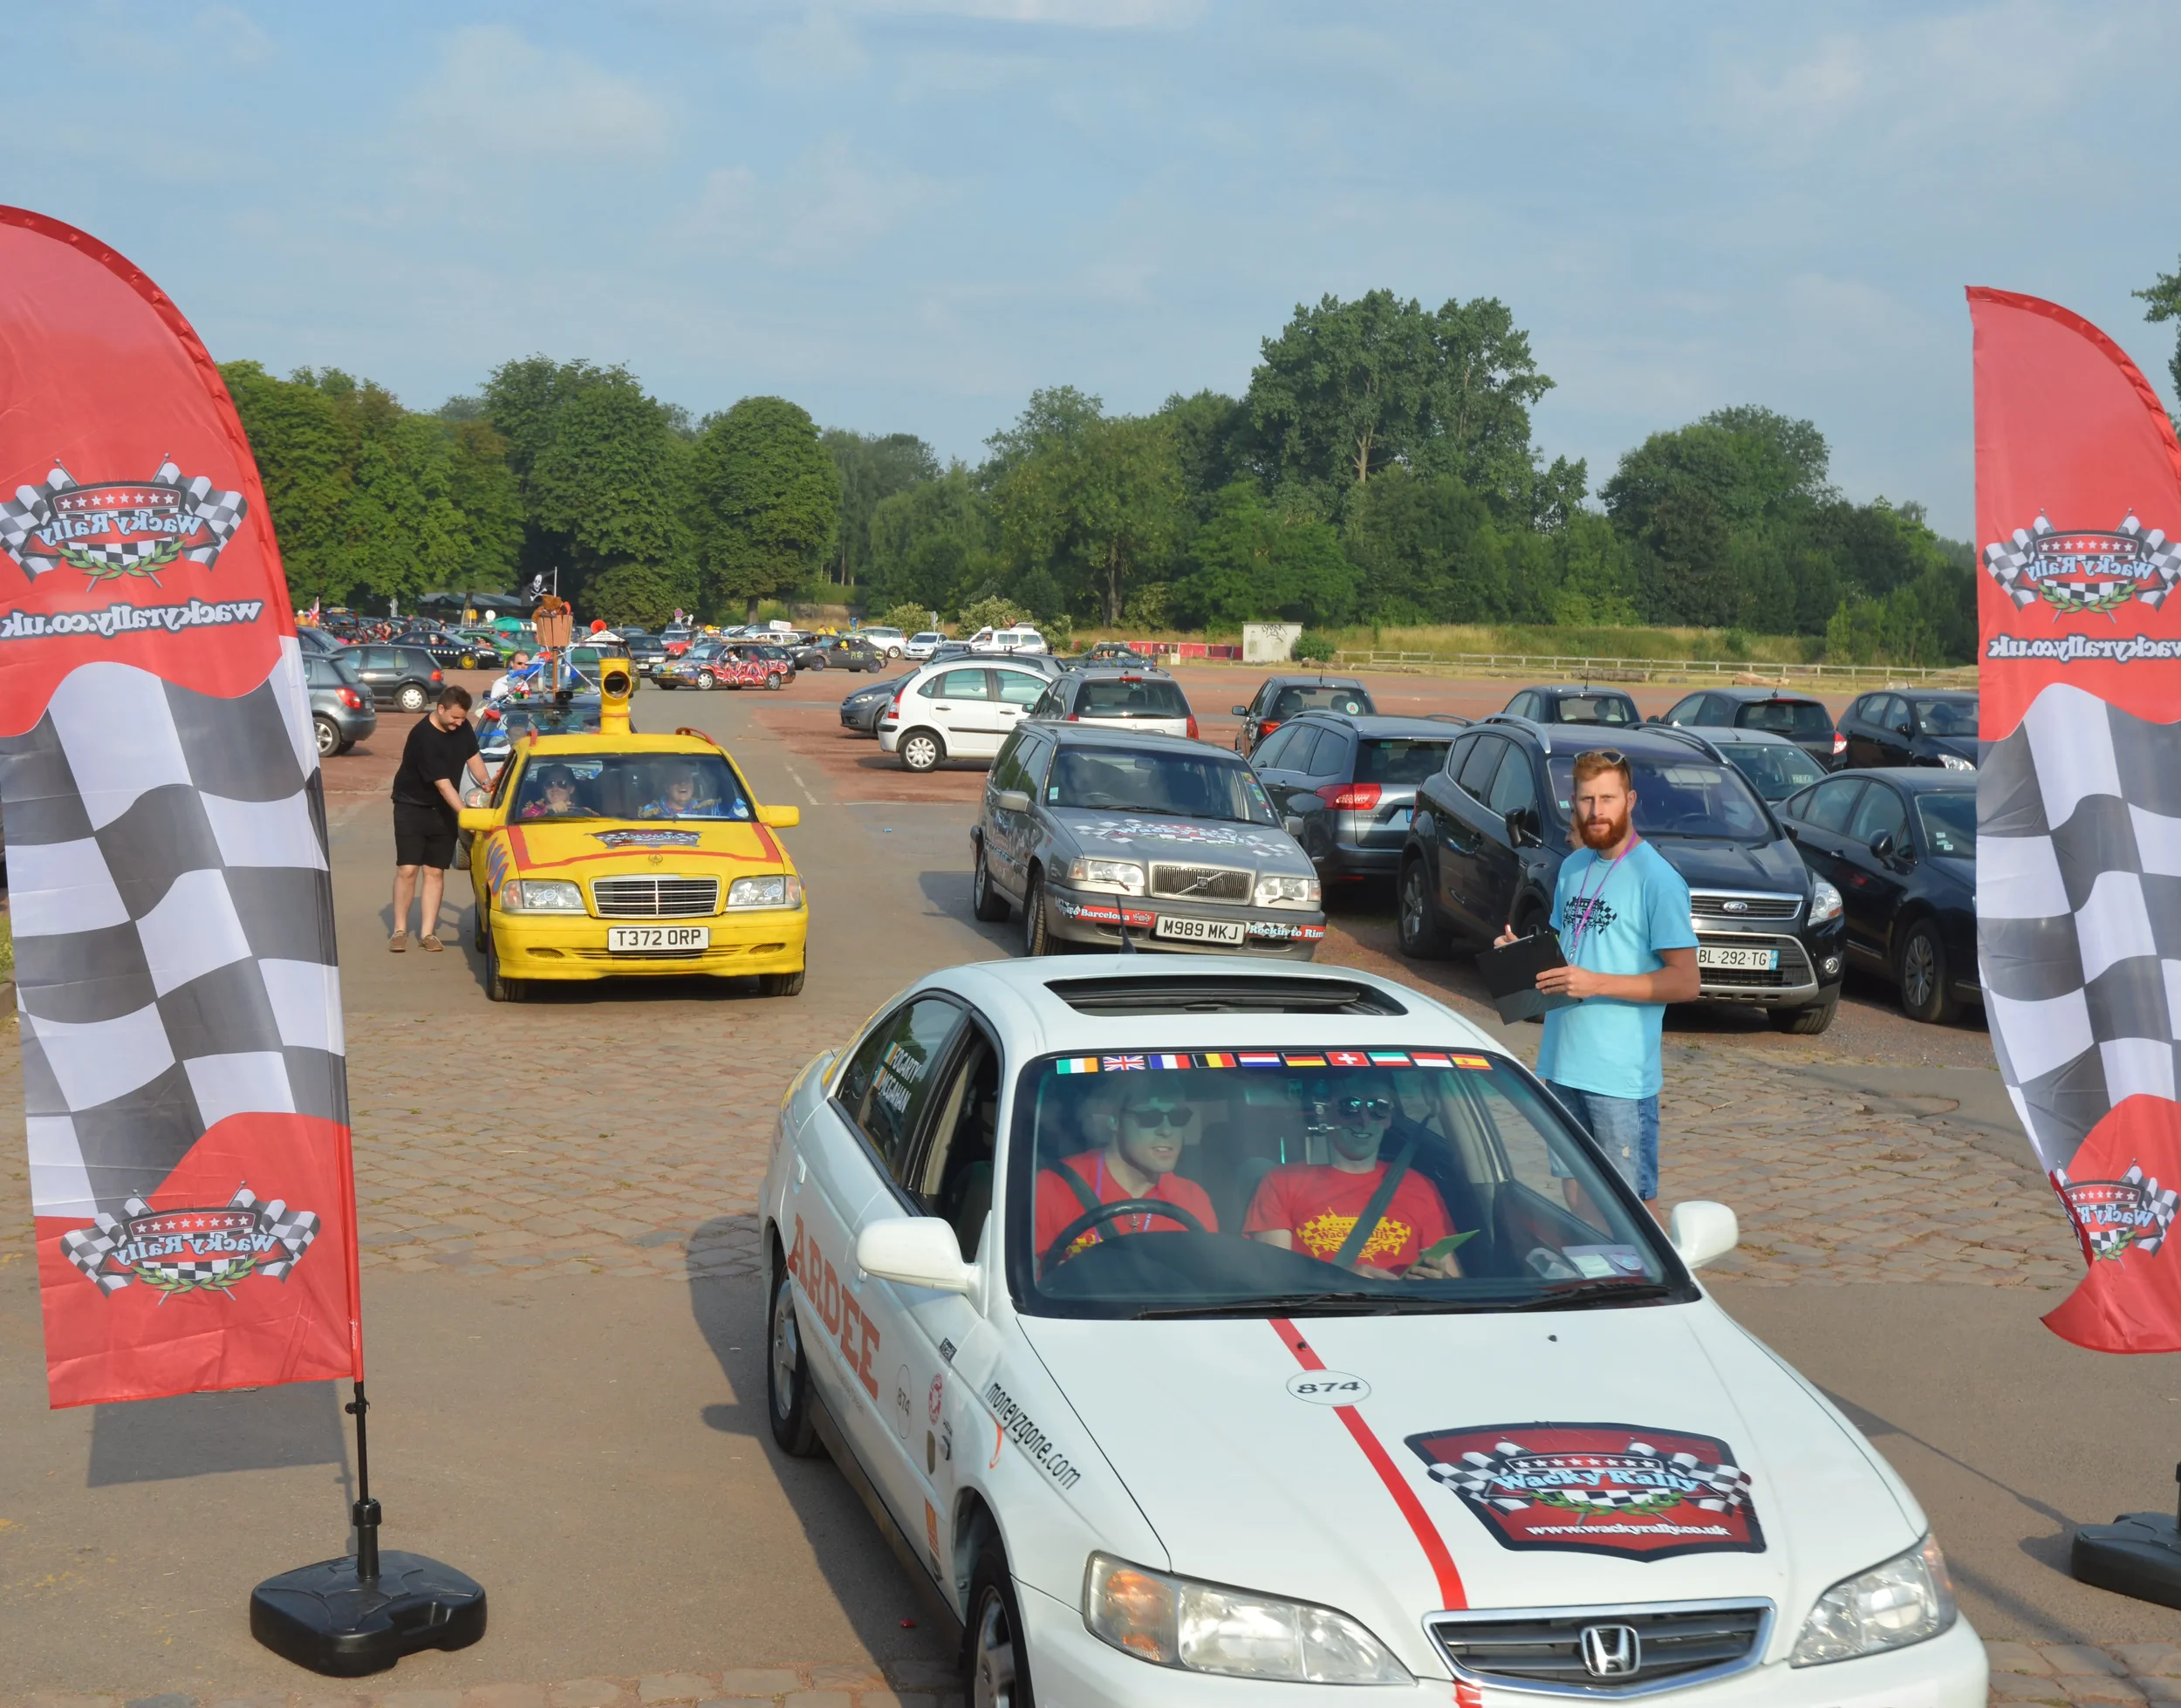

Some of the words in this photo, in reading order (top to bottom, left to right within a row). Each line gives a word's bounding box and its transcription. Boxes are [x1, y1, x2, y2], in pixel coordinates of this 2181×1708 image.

[616, 930, 662, 946] T372
[667, 929, 701, 946] ORP
[1164, 919, 1204, 937] M989
[1207, 924, 1238, 939] MKJ
[1248, 925, 1289, 936] Rockin
[1290, 928, 1302, 937] to
[1304, 929, 1325, 938] Rim
[1699, 949, 1767, 966] BL-292-TG
[890, 1047, 922, 1083] FOGARTY
[787, 1213, 881, 1401] ARDEE
[1296, 1381, 1361, 1394] 874
[897, 1387, 910, 1417] 874
[984, 1382, 1081, 1490] moneyzgone.com
[1490, 1469, 1602, 1492] Wacky
[1607, 1469, 1701, 1493] Rally
[1525, 1522, 1733, 1536] www.wackyrally.co.uk
